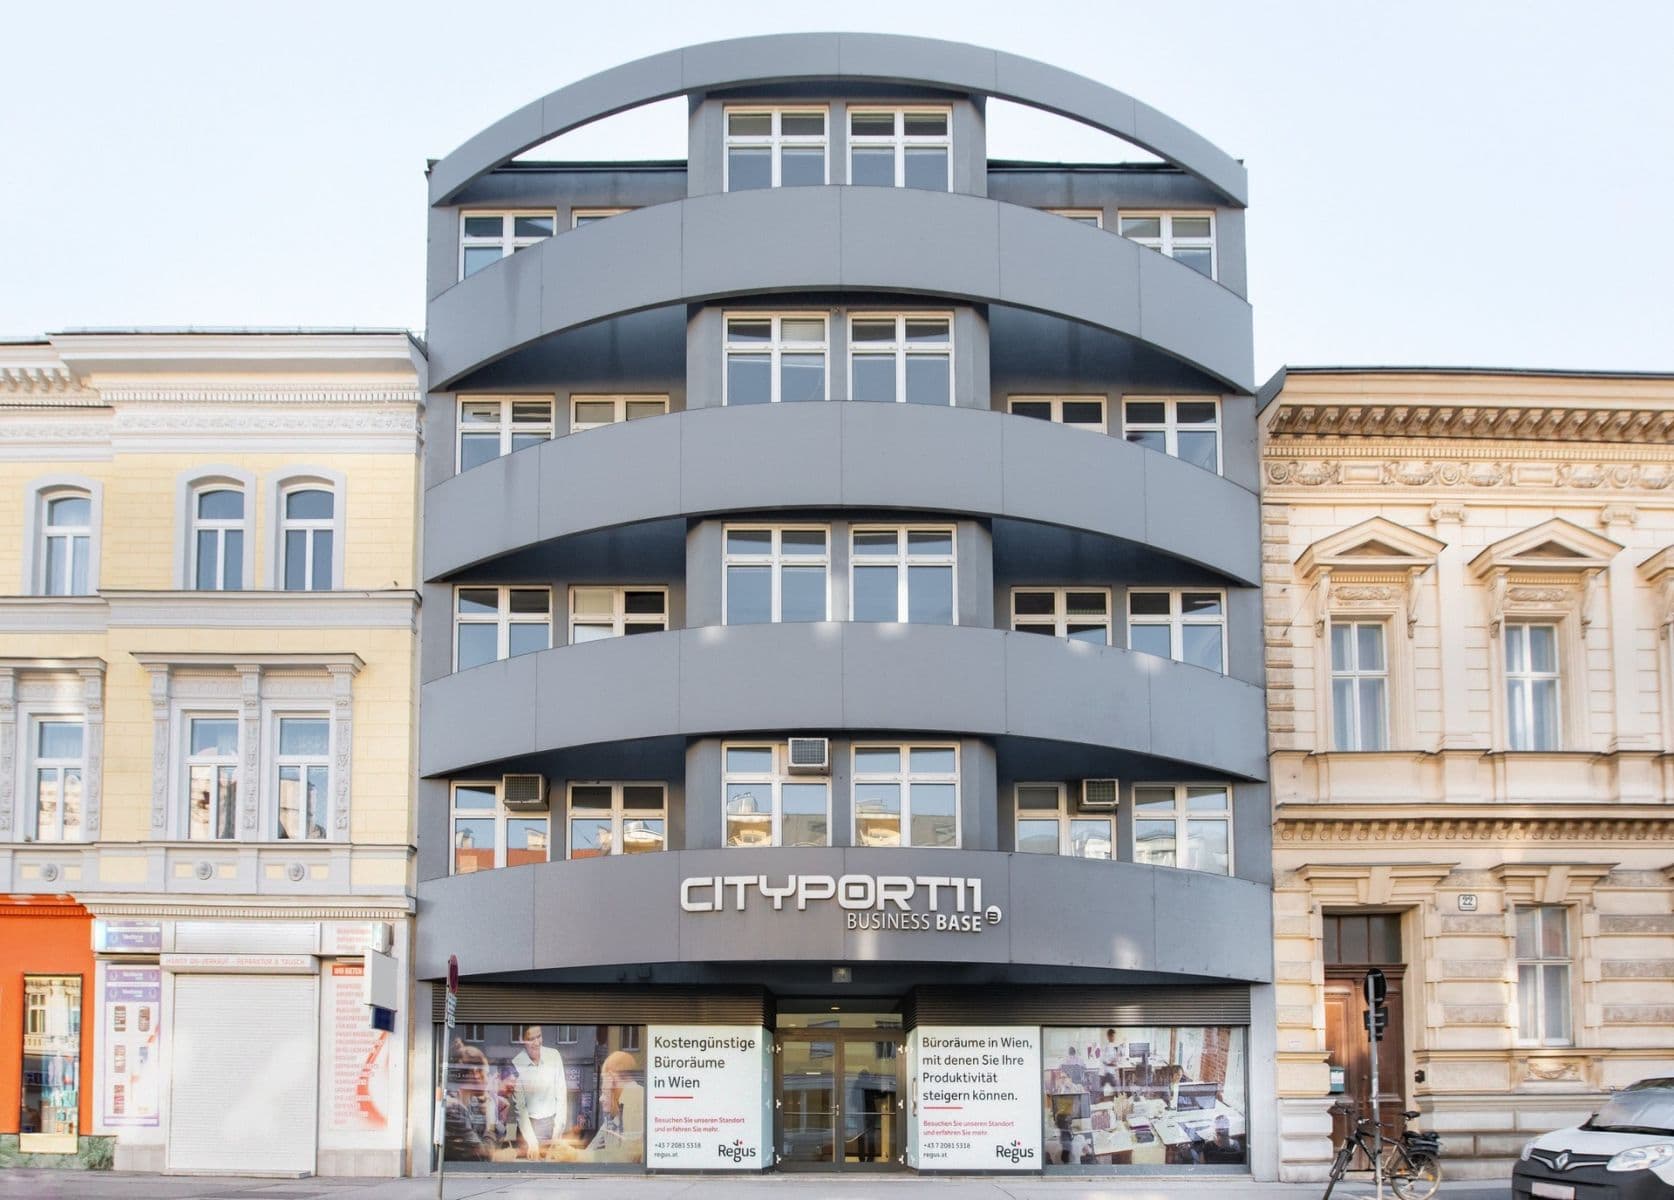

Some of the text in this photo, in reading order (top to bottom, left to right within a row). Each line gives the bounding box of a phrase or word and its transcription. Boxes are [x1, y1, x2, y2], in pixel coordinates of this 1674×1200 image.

[1462, 896, 1473, 905] 22
[847, 912, 930, 930] BUSINESS
[936, 913, 982, 932] BASE
[654, 1036, 755, 1051] Kostengünstige
[922, 1037, 1033, 1049] Büroräume in Wien,
[654, 1056, 725, 1068] Büroräume
[922, 1055, 1024, 1065] mit denen Sie Ihre
[654, 1076, 700, 1088] in Wien
[922, 1072, 998, 1083] Produktivität
[922, 1090, 1018, 1103] steigern können.
[718, 1142, 757, 1163] Regus
[995, 1143, 1034, 1164] Regus
